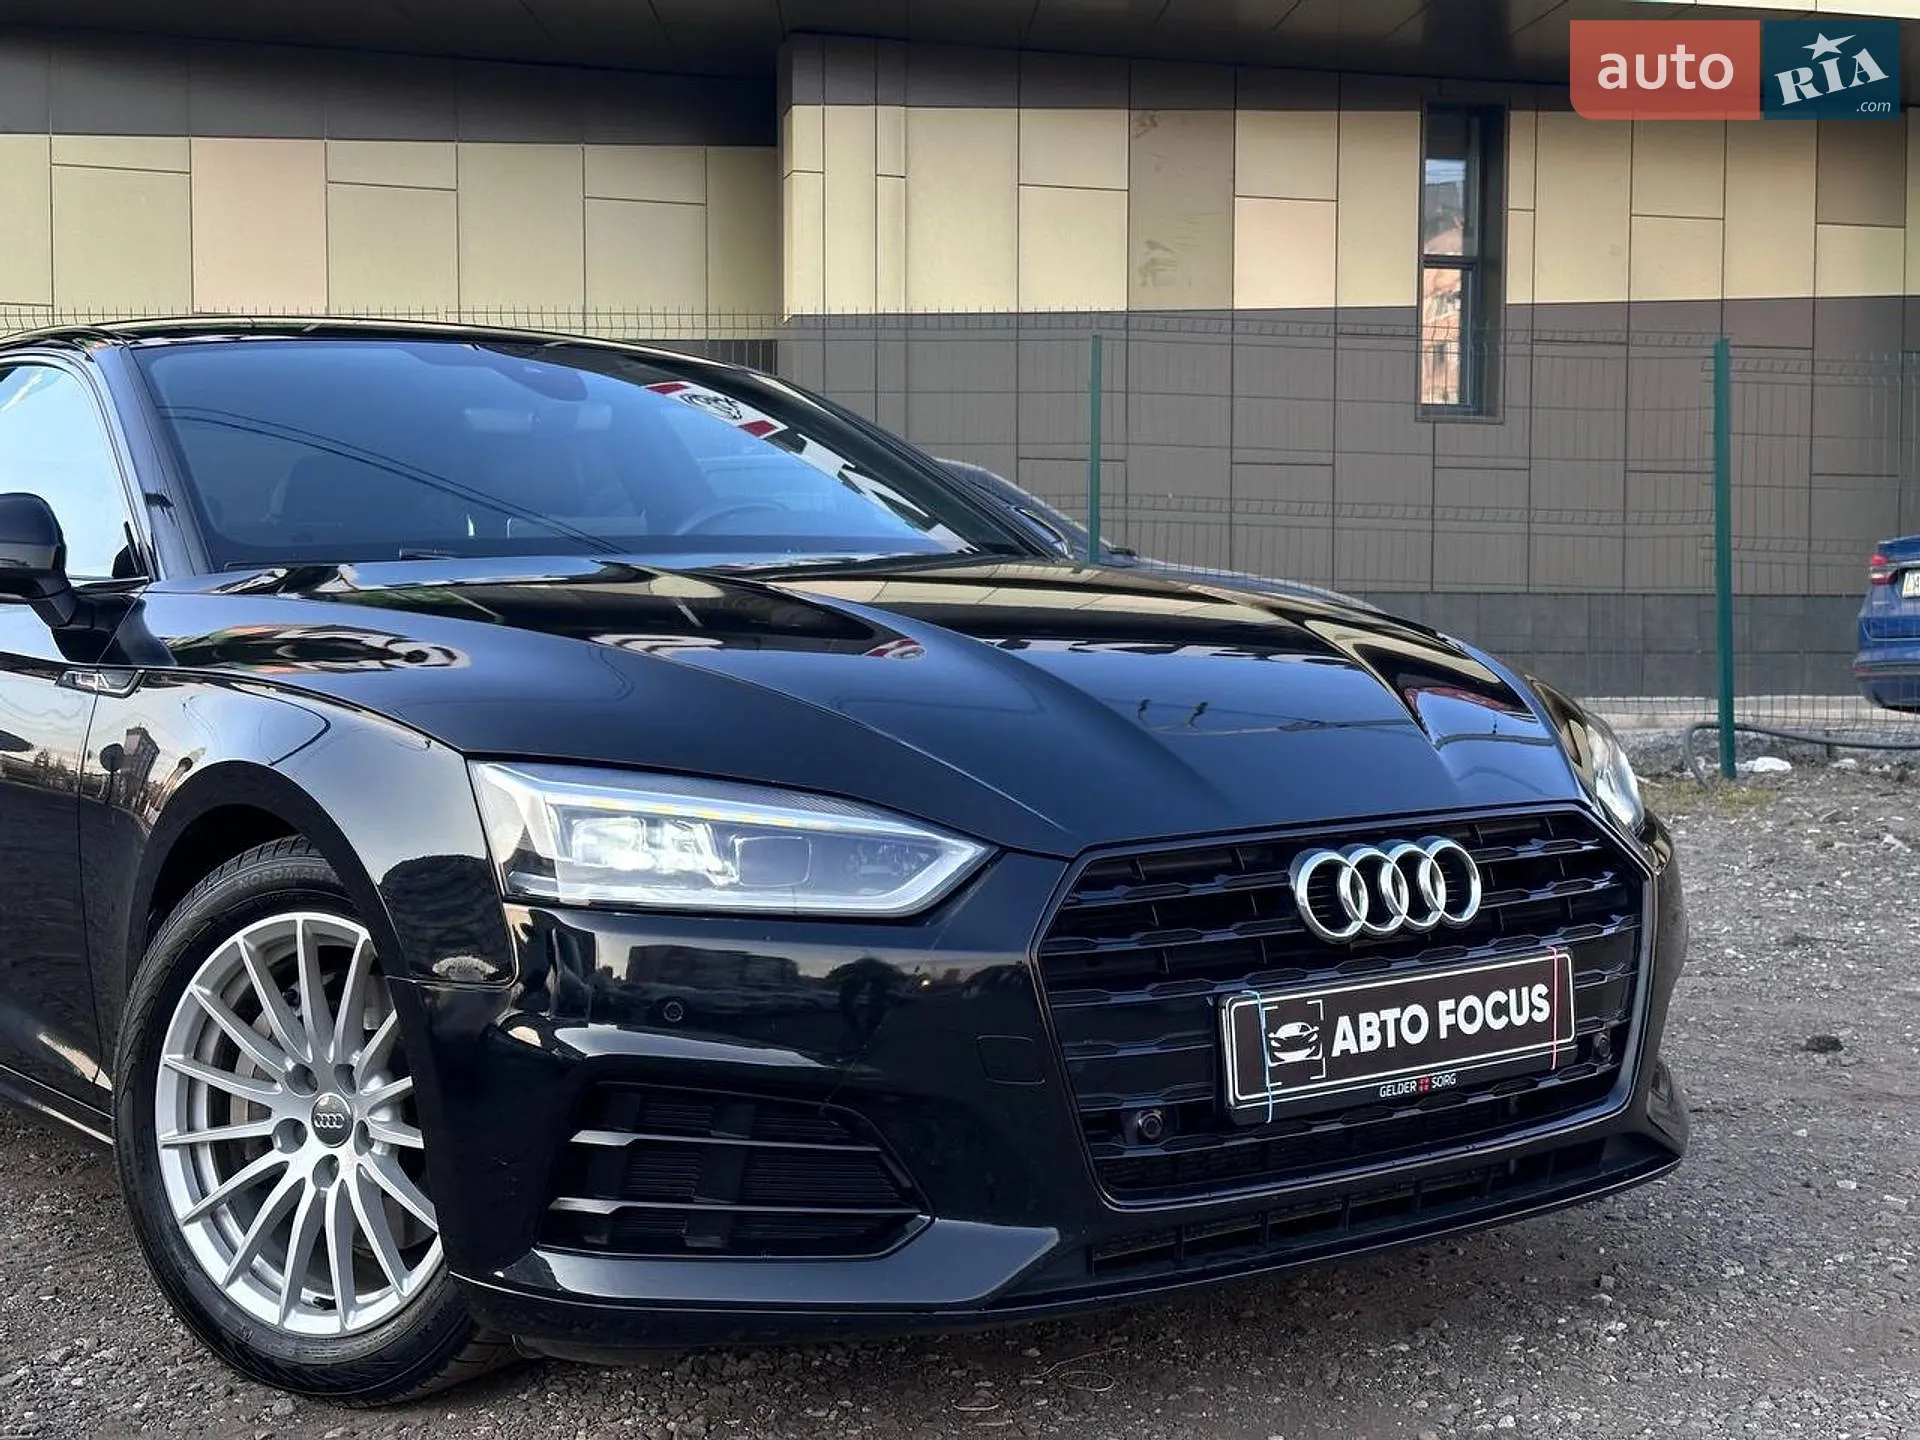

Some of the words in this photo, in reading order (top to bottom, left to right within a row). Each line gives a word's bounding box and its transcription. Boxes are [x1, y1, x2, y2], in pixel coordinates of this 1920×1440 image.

[1331, 1003, 1429, 1058] АВТО
[1438, 983, 1551, 1040] FOCUS
[1379, 1080, 1417, 1098] GELDER
[1431, 1073, 1457, 1089] SORG
